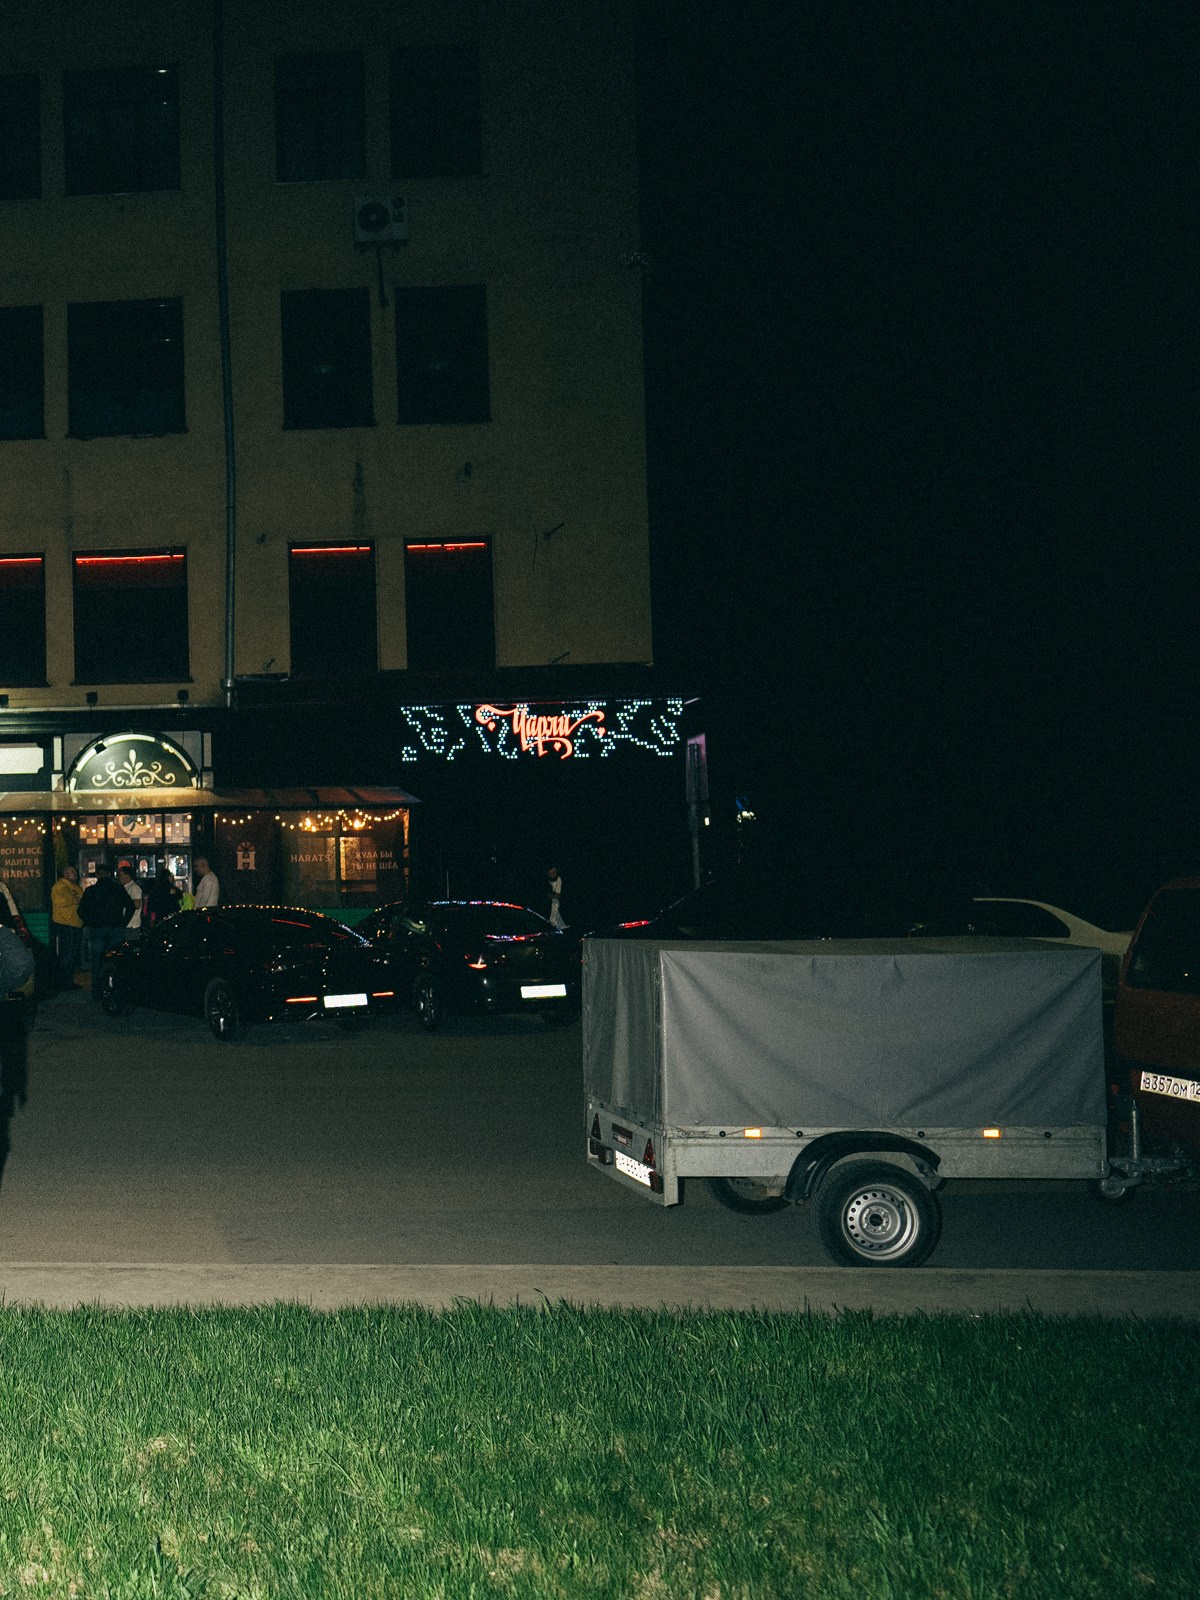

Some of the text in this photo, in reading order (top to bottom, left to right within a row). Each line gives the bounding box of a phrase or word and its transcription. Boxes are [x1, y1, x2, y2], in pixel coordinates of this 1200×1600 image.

[475, 704, 605, 760] Чарли
[290, 854, 330, 863] HARATS
[2, 870, 41, 878] HARATS
